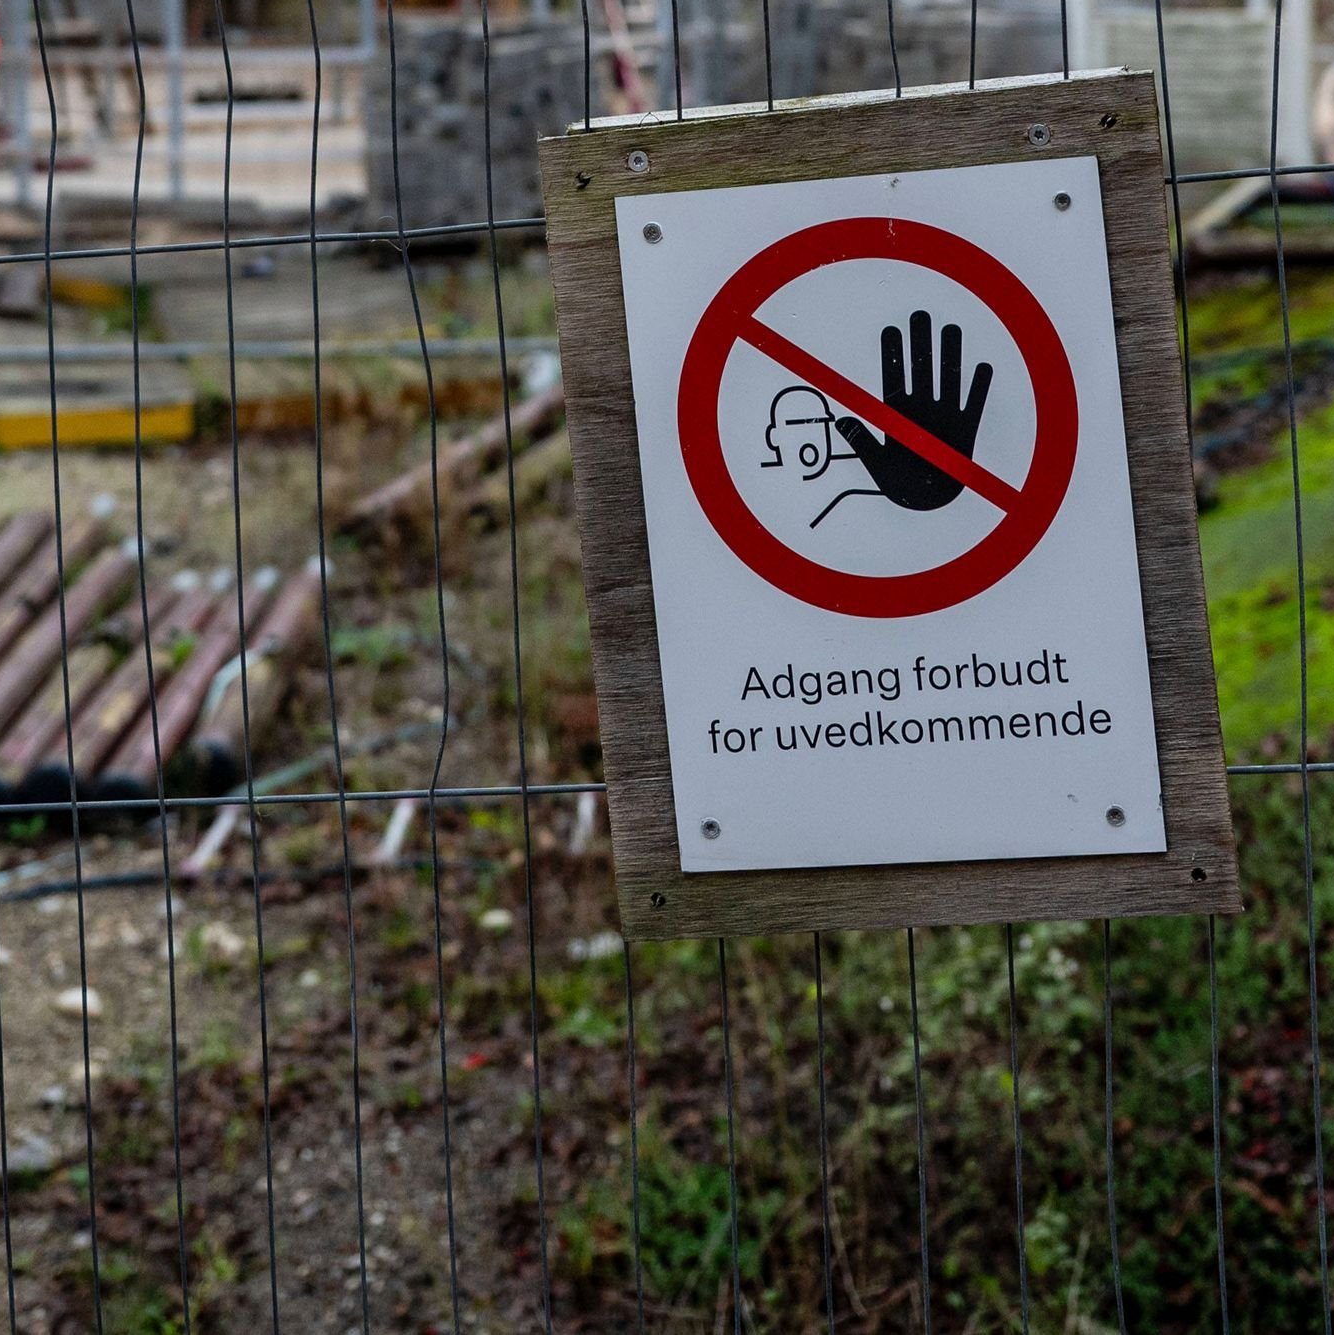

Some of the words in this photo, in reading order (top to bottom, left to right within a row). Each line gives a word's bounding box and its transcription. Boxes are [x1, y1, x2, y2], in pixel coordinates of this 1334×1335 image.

[740, 663, 902, 705] Adgang
[912, 649, 1070, 692] forbudt
[708, 719, 764, 754] for
[775, 700, 1113, 751] uvedkommende
